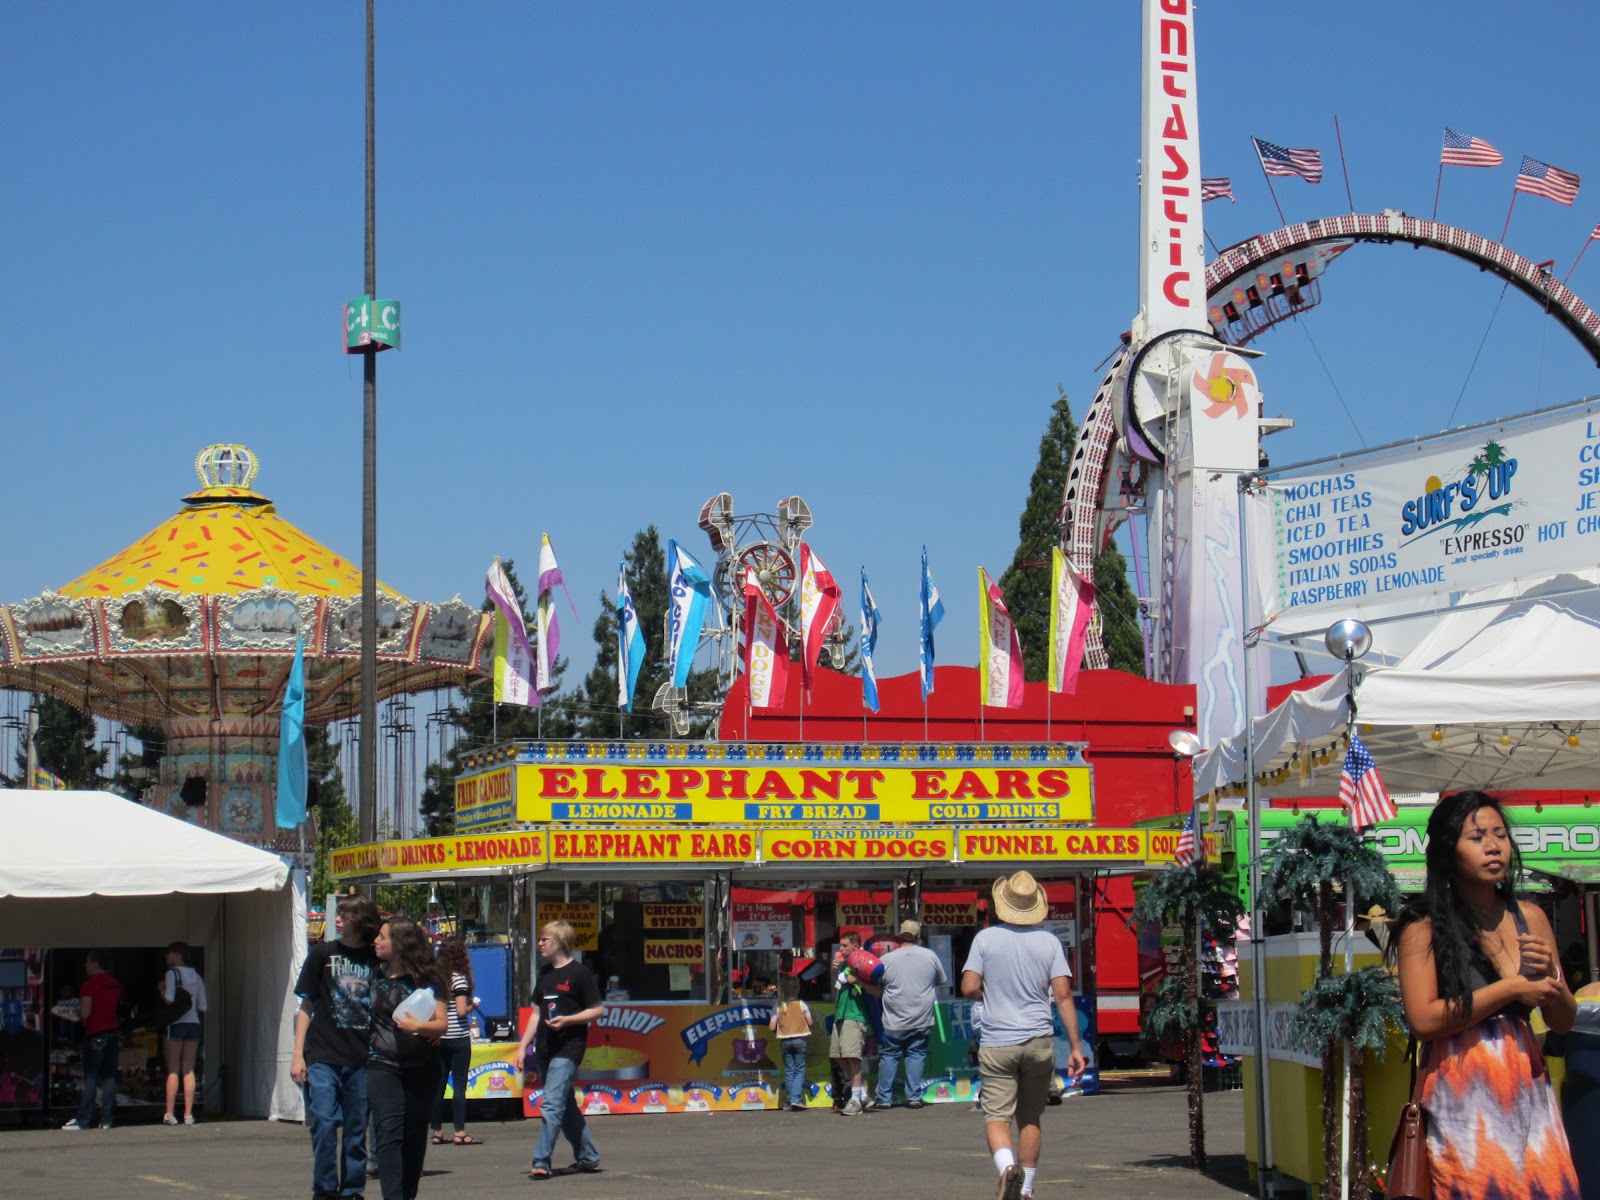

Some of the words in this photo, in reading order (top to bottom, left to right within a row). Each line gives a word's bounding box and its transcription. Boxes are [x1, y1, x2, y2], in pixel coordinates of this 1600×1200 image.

[1586, 422, 1600, 438] L
[1284, 474, 1356, 503] MOCHAS
[1401, 474, 1476, 536] SURF'S
[1489, 458, 1518, 500] UP
[1286, 502, 1321, 524] CHAI
[1331, 491, 1372, 514] TEAS
[1576, 491, 1600, 512] JE
[1286, 522, 1326, 544] ICED
[1336, 512, 1370, 534] TEA
[1538, 520, 1568, 542] HOT
[1577, 516, 1600, 534] CH
[1288, 532, 1384, 565] SMOOTHIES
[1503, 546, 1524, 556] drinks
[1290, 562, 1340, 586] ITALIAN
[1348, 552, 1397, 576] SODAS
[1290, 578, 1368, 607] RASPBERRY
[1376, 565, 1446, 592] LEMONADE
[751, 645, 770, 700] DOGS
[991, 655, 1006, 698] CAKE
[457, 780, 478, 808] FRIED
[538, 768, 885, 800] ELEPHANT
[910, 770, 1070, 800] EARS
[568, 804, 676, 819] LEMONADE
[758, 806, 794, 818] FRY
[802, 806, 866, 818] BREAD
[931, 804, 980, 818] COLD
[988, 804, 1058, 818] DRINKS
[554, 834, 681, 858] ELEPHANT
[691, 834, 752, 858] EARS
[812, 830, 856, 840] HAND
[860, 830, 915, 840] DIPPED
[965, 836, 1058, 856] FUNNEL
[1066, 835, 1141, 856] CAKES
[1510, 826, 1600, 853] BRO
[402, 843, 446, 866] DRINKS
[456, 836, 542, 862] LEMONADE
[771, 840, 857, 859] CORN
[864, 840, 946, 858] DOGS
[644, 905, 702, 916] CHICKEN
[841, 904, 888, 915] CURLY
[846, 915, 886, 926] FRIES
[922, 914, 974, 925] CONES
[924, 904, 972, 914] SNOW
[650, 917, 697, 928] STRIPS
[646, 944, 703, 958] NACHOS
[597, 1008, 666, 1036] CANDY
[686, 1008, 773, 1045] ELEPHANT
